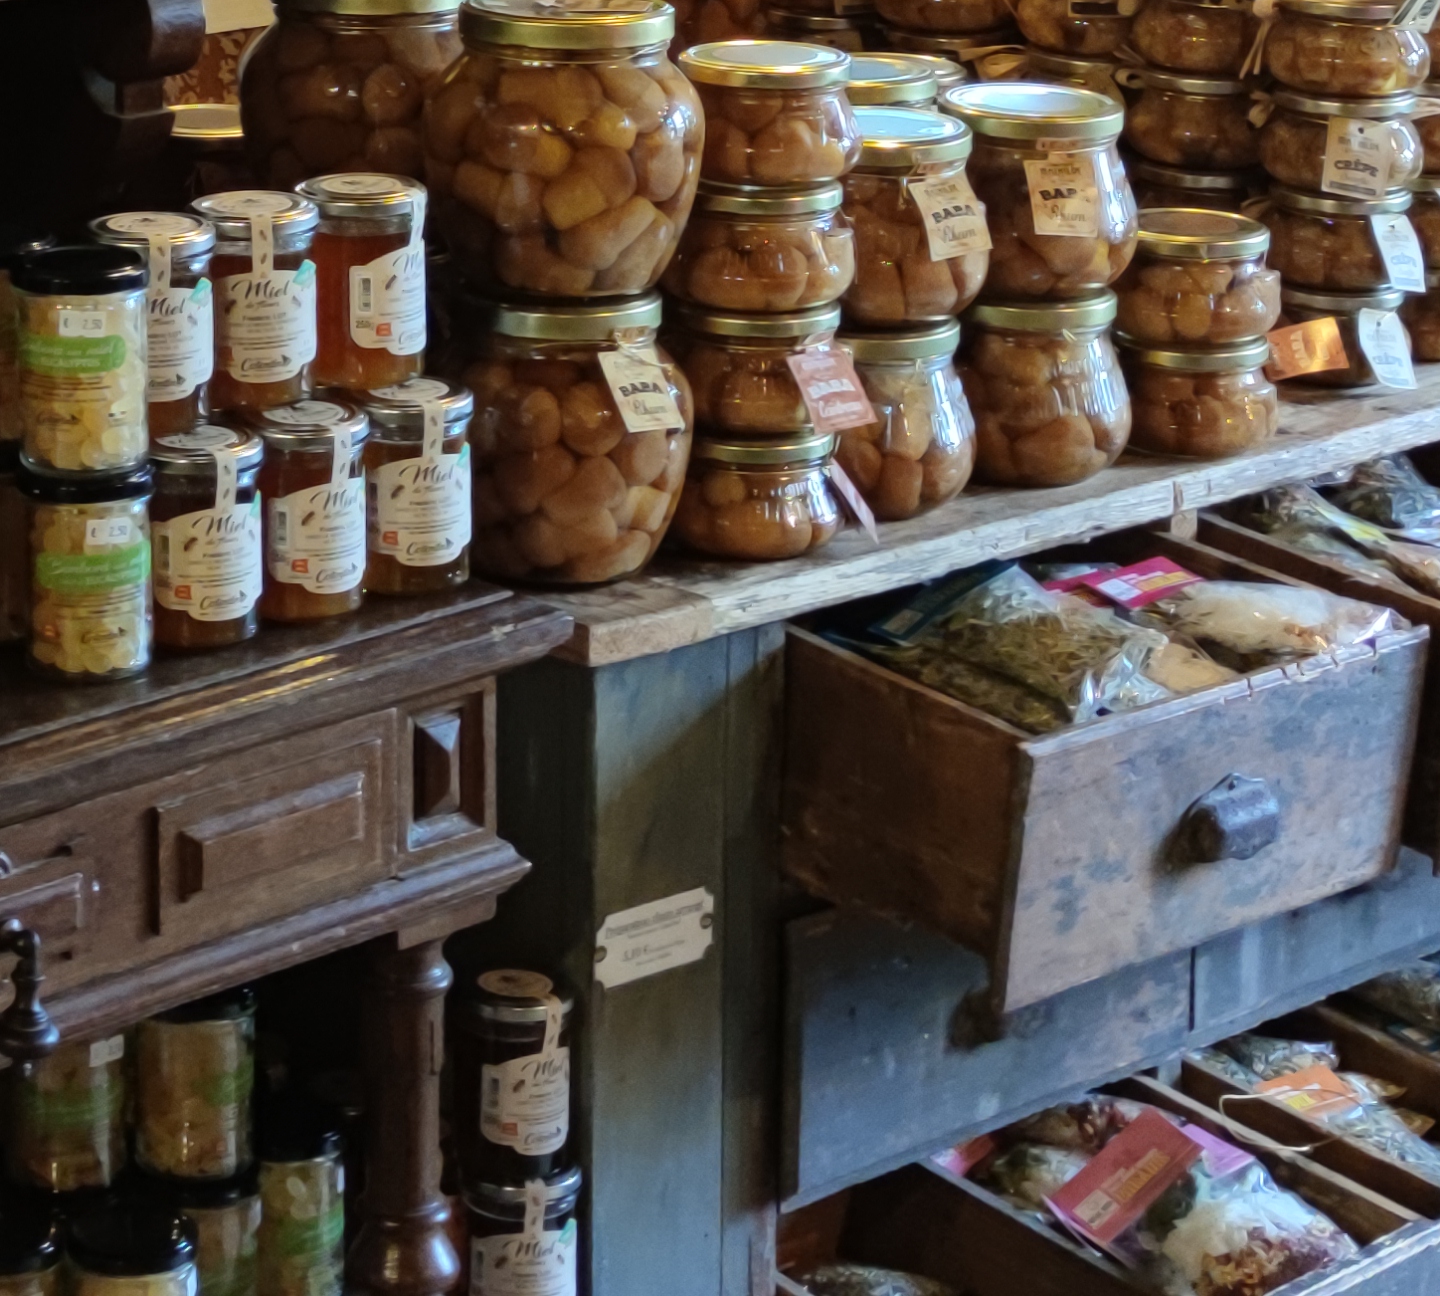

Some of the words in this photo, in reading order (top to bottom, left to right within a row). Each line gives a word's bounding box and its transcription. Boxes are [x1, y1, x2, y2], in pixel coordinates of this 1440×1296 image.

[1333, 158, 1380, 178] CRÊPE
[931, 204, 977, 224] BABA
[232, 280, 291, 300] Miel
[618, 381, 665, 398] BABA
[399, 461, 454, 485] Miel
[310, 489, 358, 511] Miel
[191, 514, 248, 537] Miel
